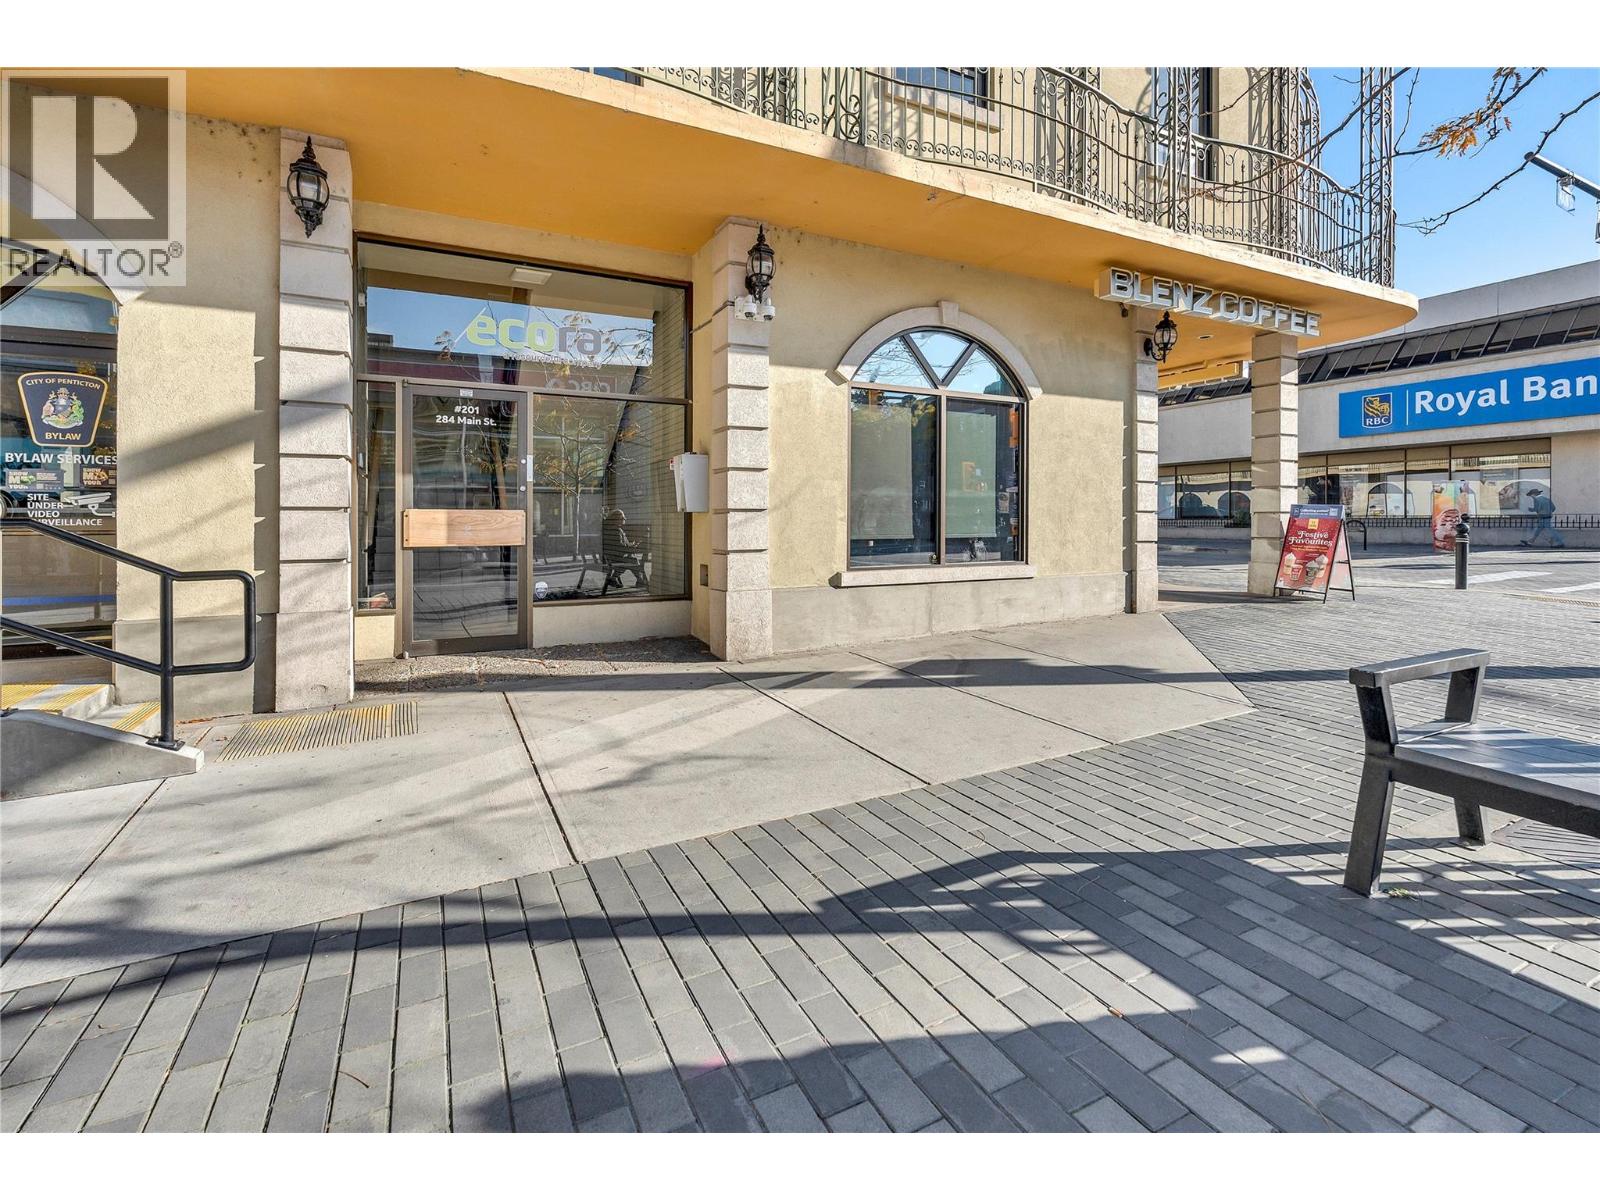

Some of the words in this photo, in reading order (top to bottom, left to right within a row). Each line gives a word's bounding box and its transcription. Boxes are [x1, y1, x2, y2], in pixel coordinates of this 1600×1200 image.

[1110, 267, 1213, 315] BLENZ
[1219, 290, 1321, 337] COFFEE
[467, 315, 601, 355] ecora
[57, 378, 101, 390] PENTICTON
[1415, 379, 1510, 416] Royal
[1523, 374, 1598, 402] Ban
[454, 405, 480, 414] #201
[435, 415, 455, 424] 284
[457, 416, 482, 426] Main
[483, 417, 497, 426] St.
[1366, 416, 1389, 426] RBC
[45, 432, 82, 441] BYLAW
[5, 452, 54, 463] BYLAW
[57, 454, 117, 465] SERVICES
[33, 518, 103, 526] RVEILLANCE
[1297, 531, 1329, 539] Festive
